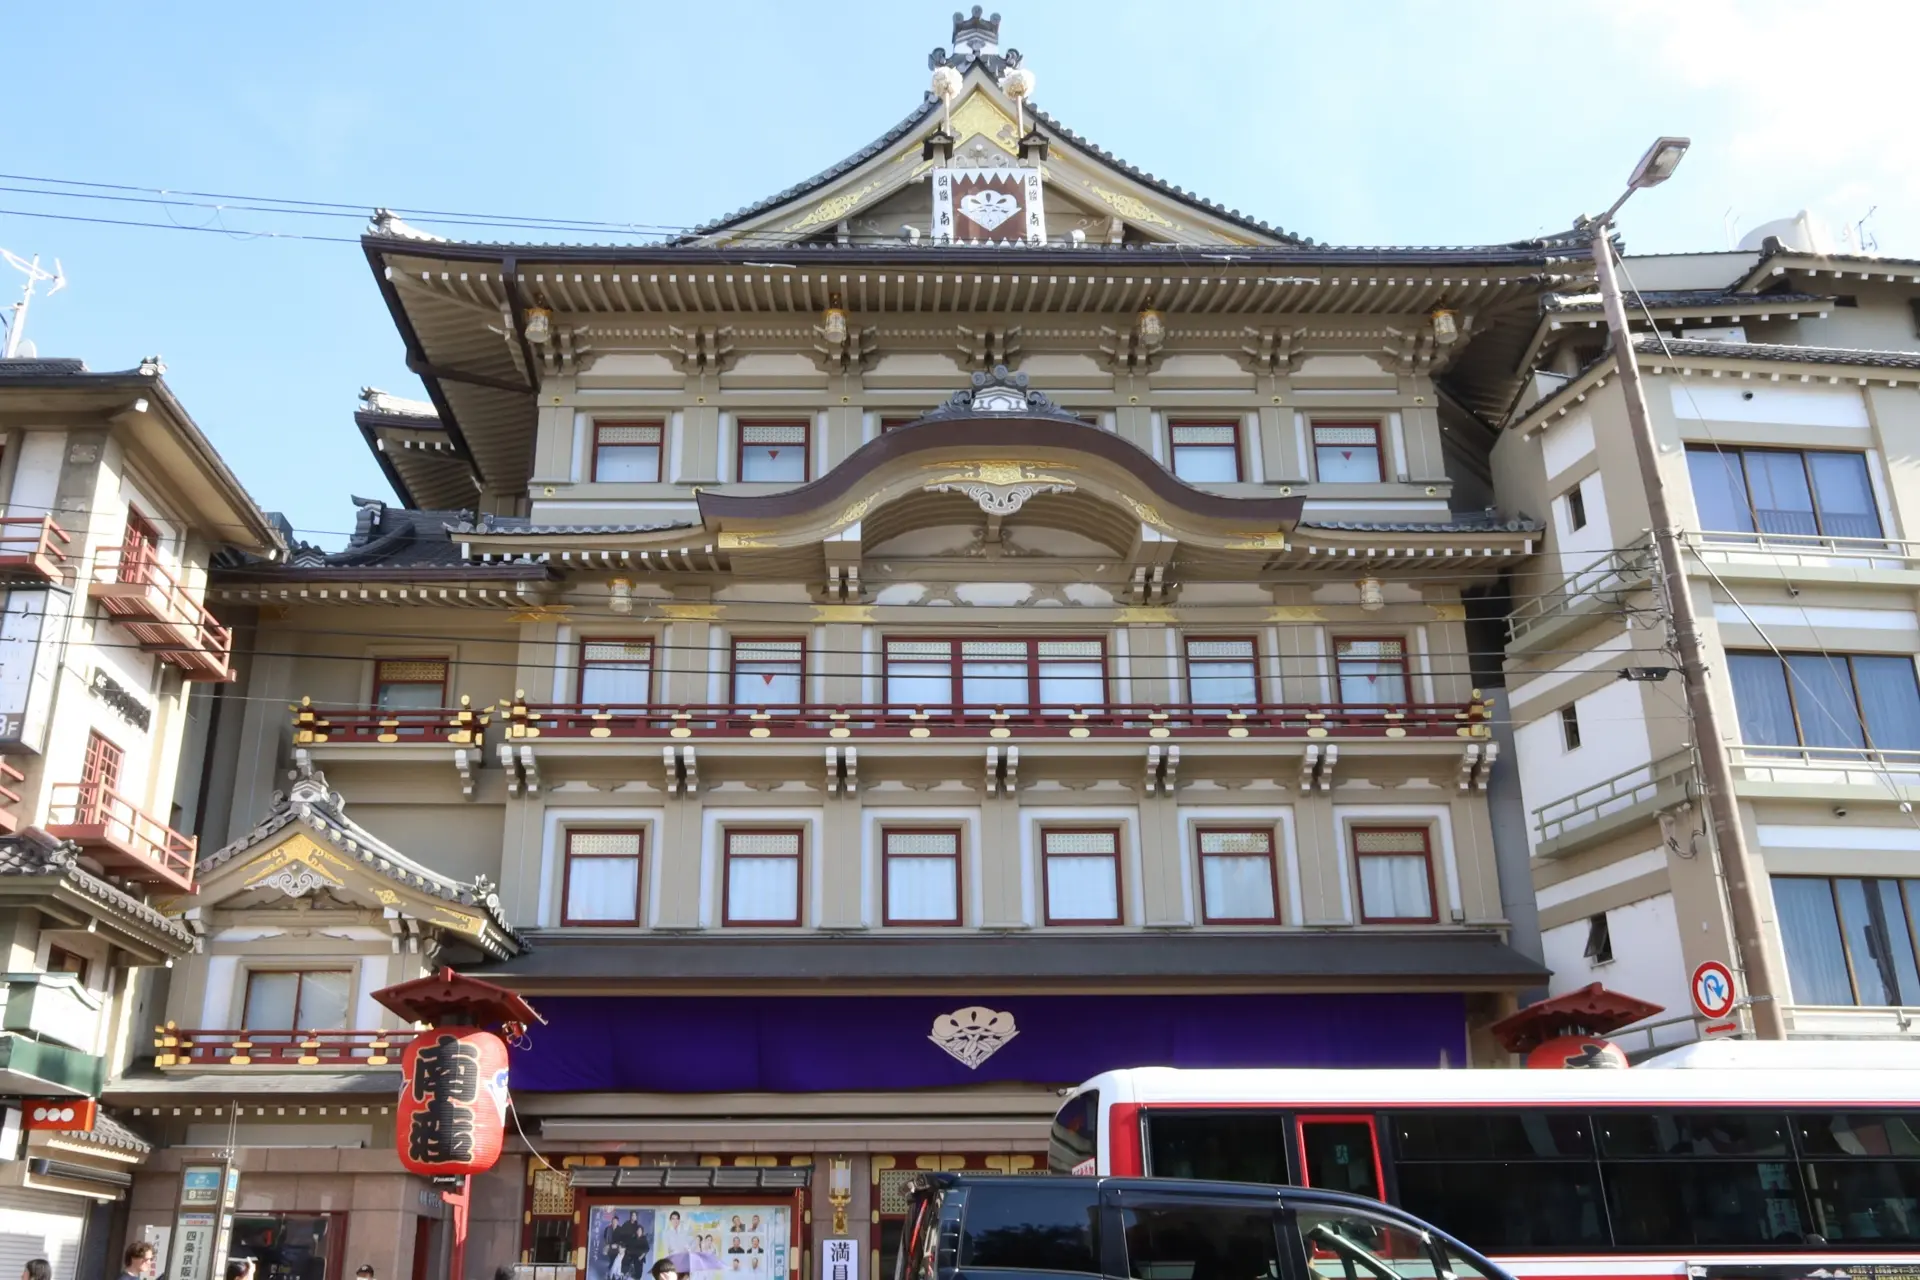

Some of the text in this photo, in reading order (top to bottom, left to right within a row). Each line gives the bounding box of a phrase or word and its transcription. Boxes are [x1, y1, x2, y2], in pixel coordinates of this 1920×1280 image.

[409, 1033, 480, 1164] 南座
[180, 1231, 197, 1280] 四条京阪
